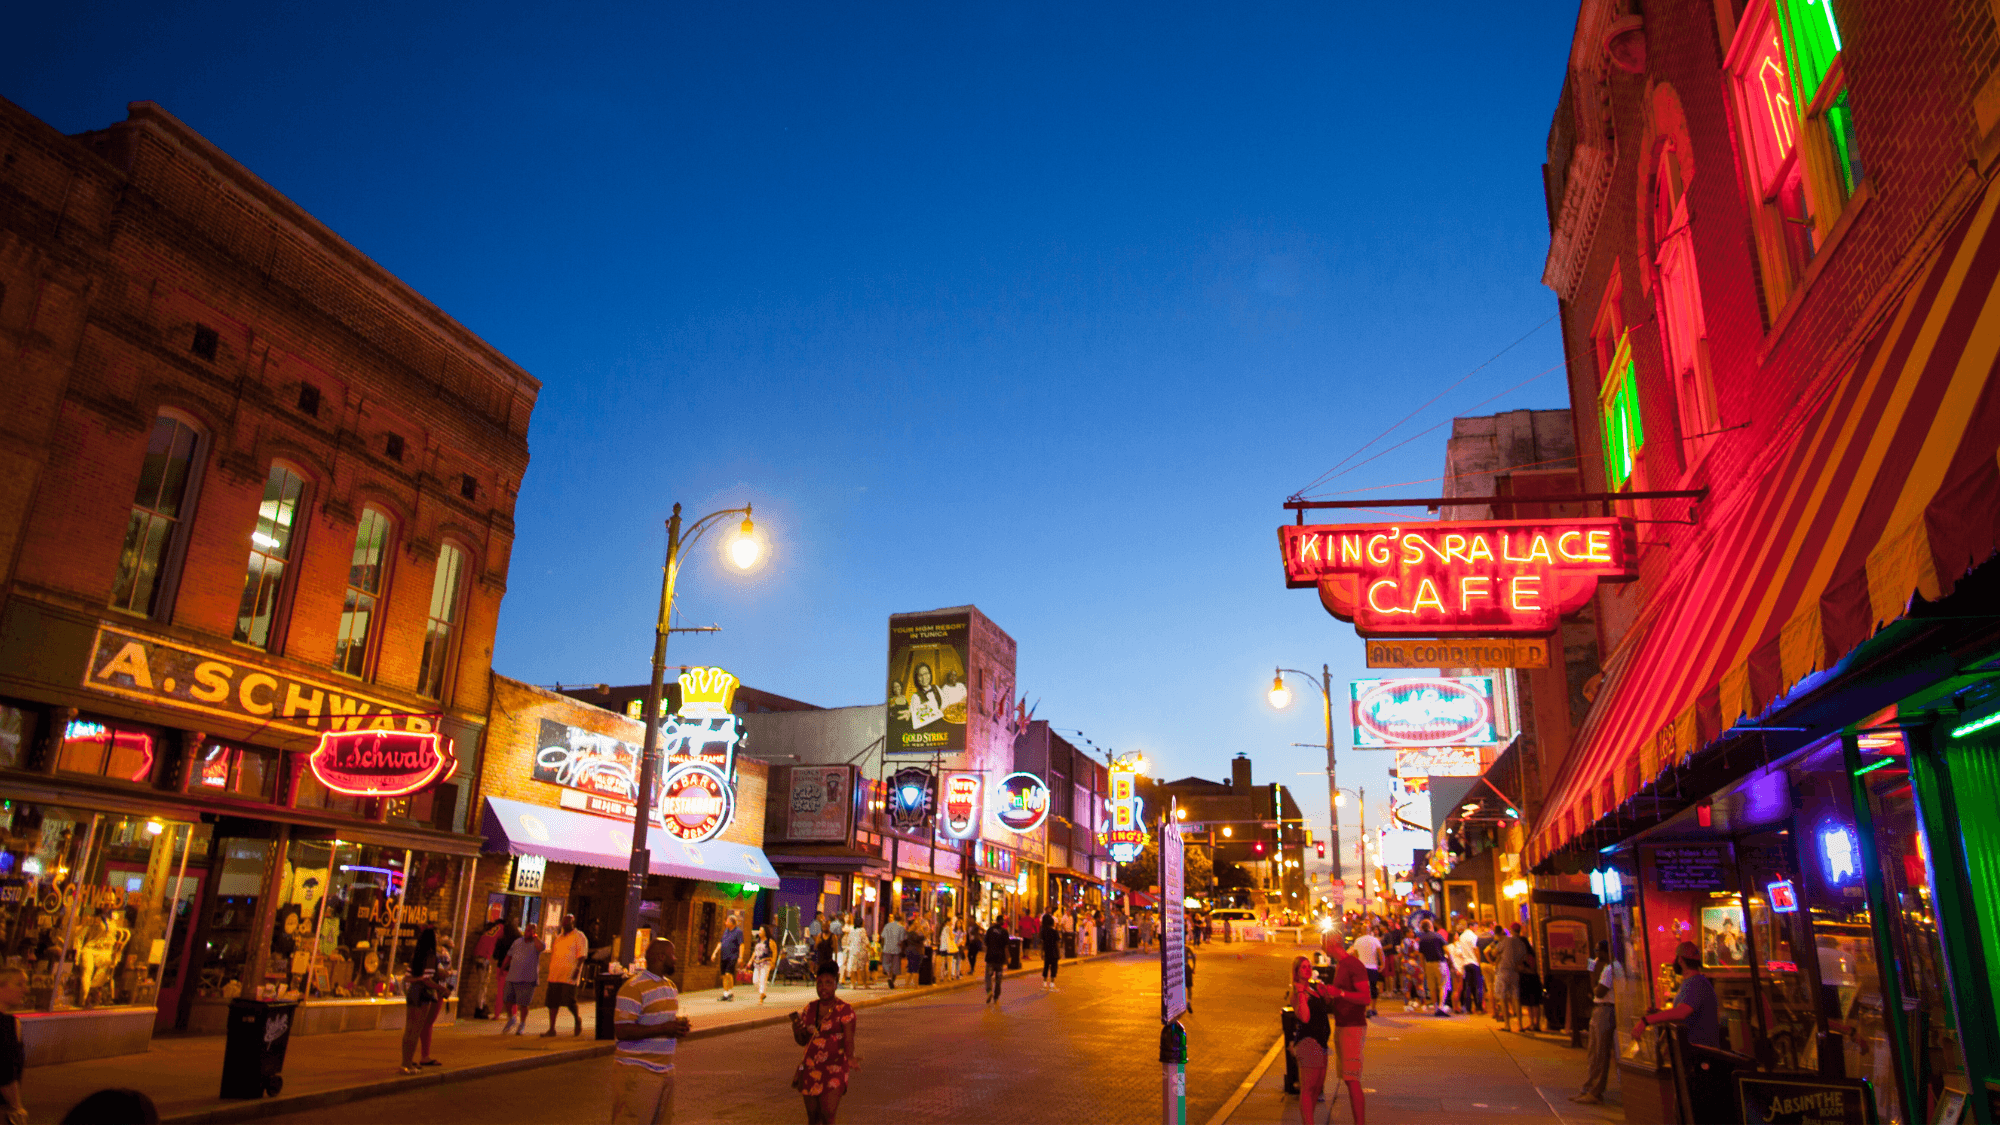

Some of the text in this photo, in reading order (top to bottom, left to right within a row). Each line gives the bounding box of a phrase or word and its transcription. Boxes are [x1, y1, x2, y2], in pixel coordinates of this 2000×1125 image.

[1300, 527, 1424, 564] KING'S
[1368, 577, 1541, 614] CAFE
[893, 626, 914, 634] YOUR
[920, 630, 948, 638] TUNICA
[1373, 646, 1404, 664] AIR
[902, 732, 949, 743] GOLD STRIKE
[320, 737, 434, 768] A. Schwab
[703, 754, 726, 764] FAME
[680, 774, 711, 788] BAR
[663, 796, 723, 816] RESTAURANT
[518, 869, 541, 889] BEER
[1762, 1091, 1844, 1122] ABSINTHE
[1818, 1107, 1844, 1117] ROOM
